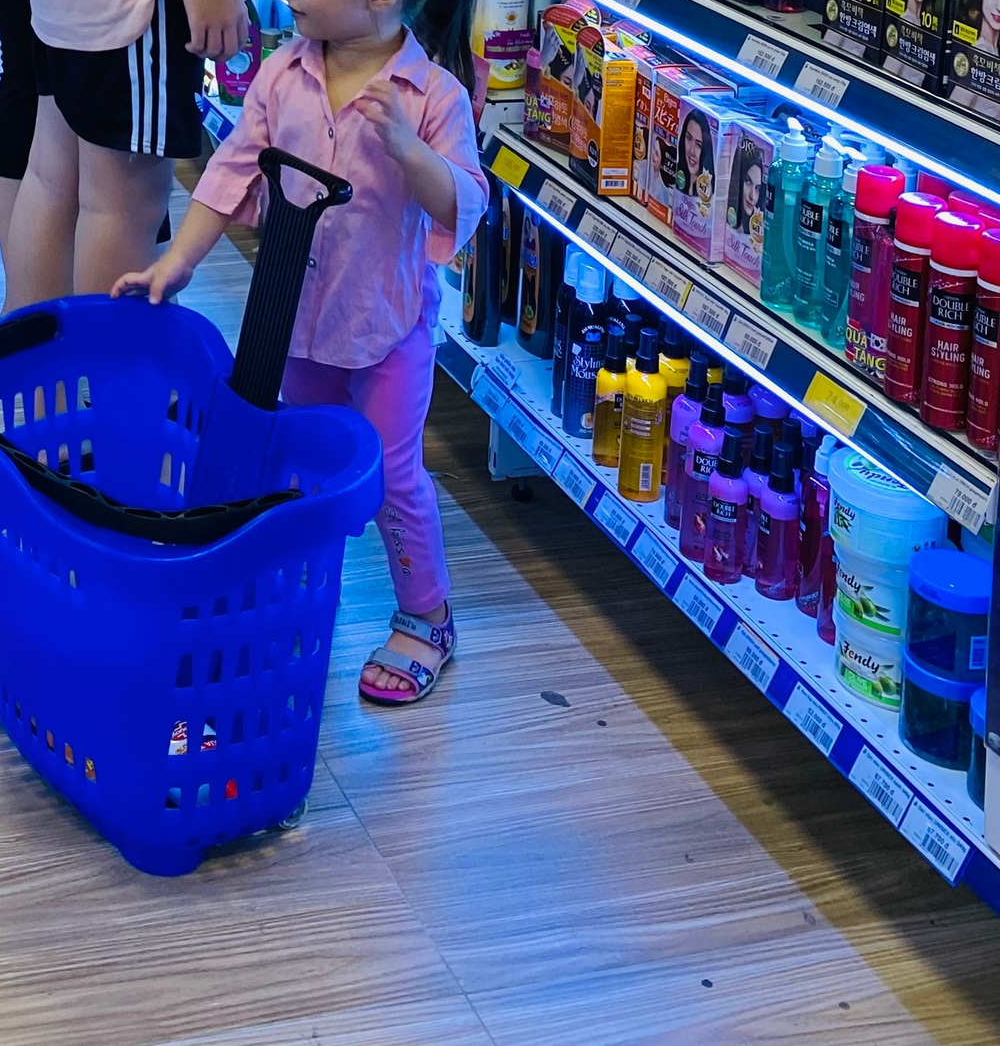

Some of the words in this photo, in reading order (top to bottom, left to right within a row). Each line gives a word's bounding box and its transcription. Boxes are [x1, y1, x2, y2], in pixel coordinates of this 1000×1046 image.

[921, 11, 932, 28] 10
[688, 209, 707, 235] Touch
[740, 241, 760, 268] Touch
[932, 295, 970, 312] DOUBLE
[938, 306, 963, 321] RICH
[937, 339, 959, 352] HAIR
[930, 346, 965, 363] STYLING
[842, 639, 881, 674] Fendy
